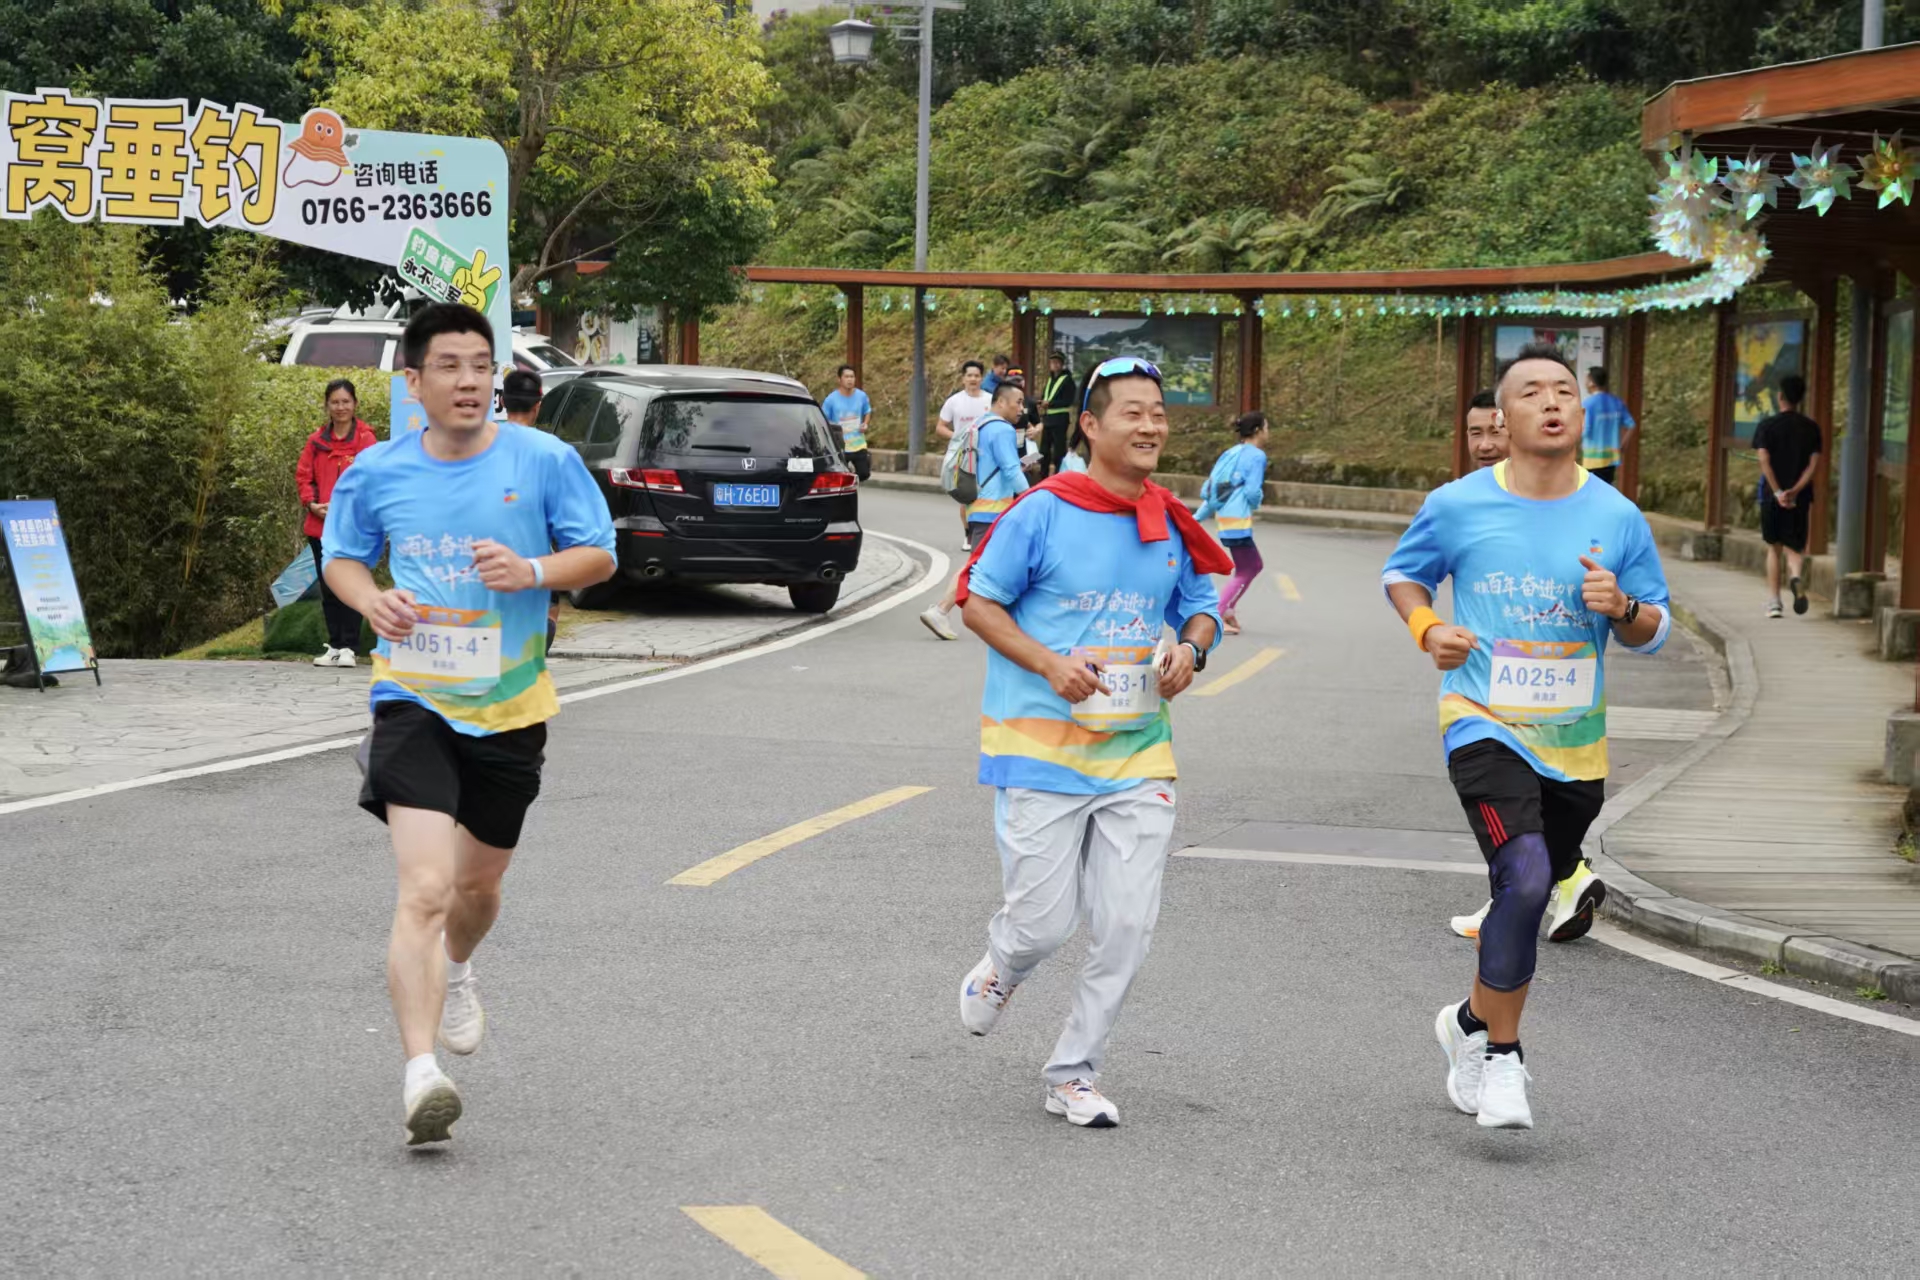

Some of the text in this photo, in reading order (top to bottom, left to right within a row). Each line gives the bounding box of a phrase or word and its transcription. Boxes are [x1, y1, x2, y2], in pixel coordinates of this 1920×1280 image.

[7, 94, 281, 226] 窝垂钓
[354, 160, 438, 187] 咨询电话
[302, 191, 492, 225] 0766-2363666
[1497, 664, 1577, 687] A025-4
